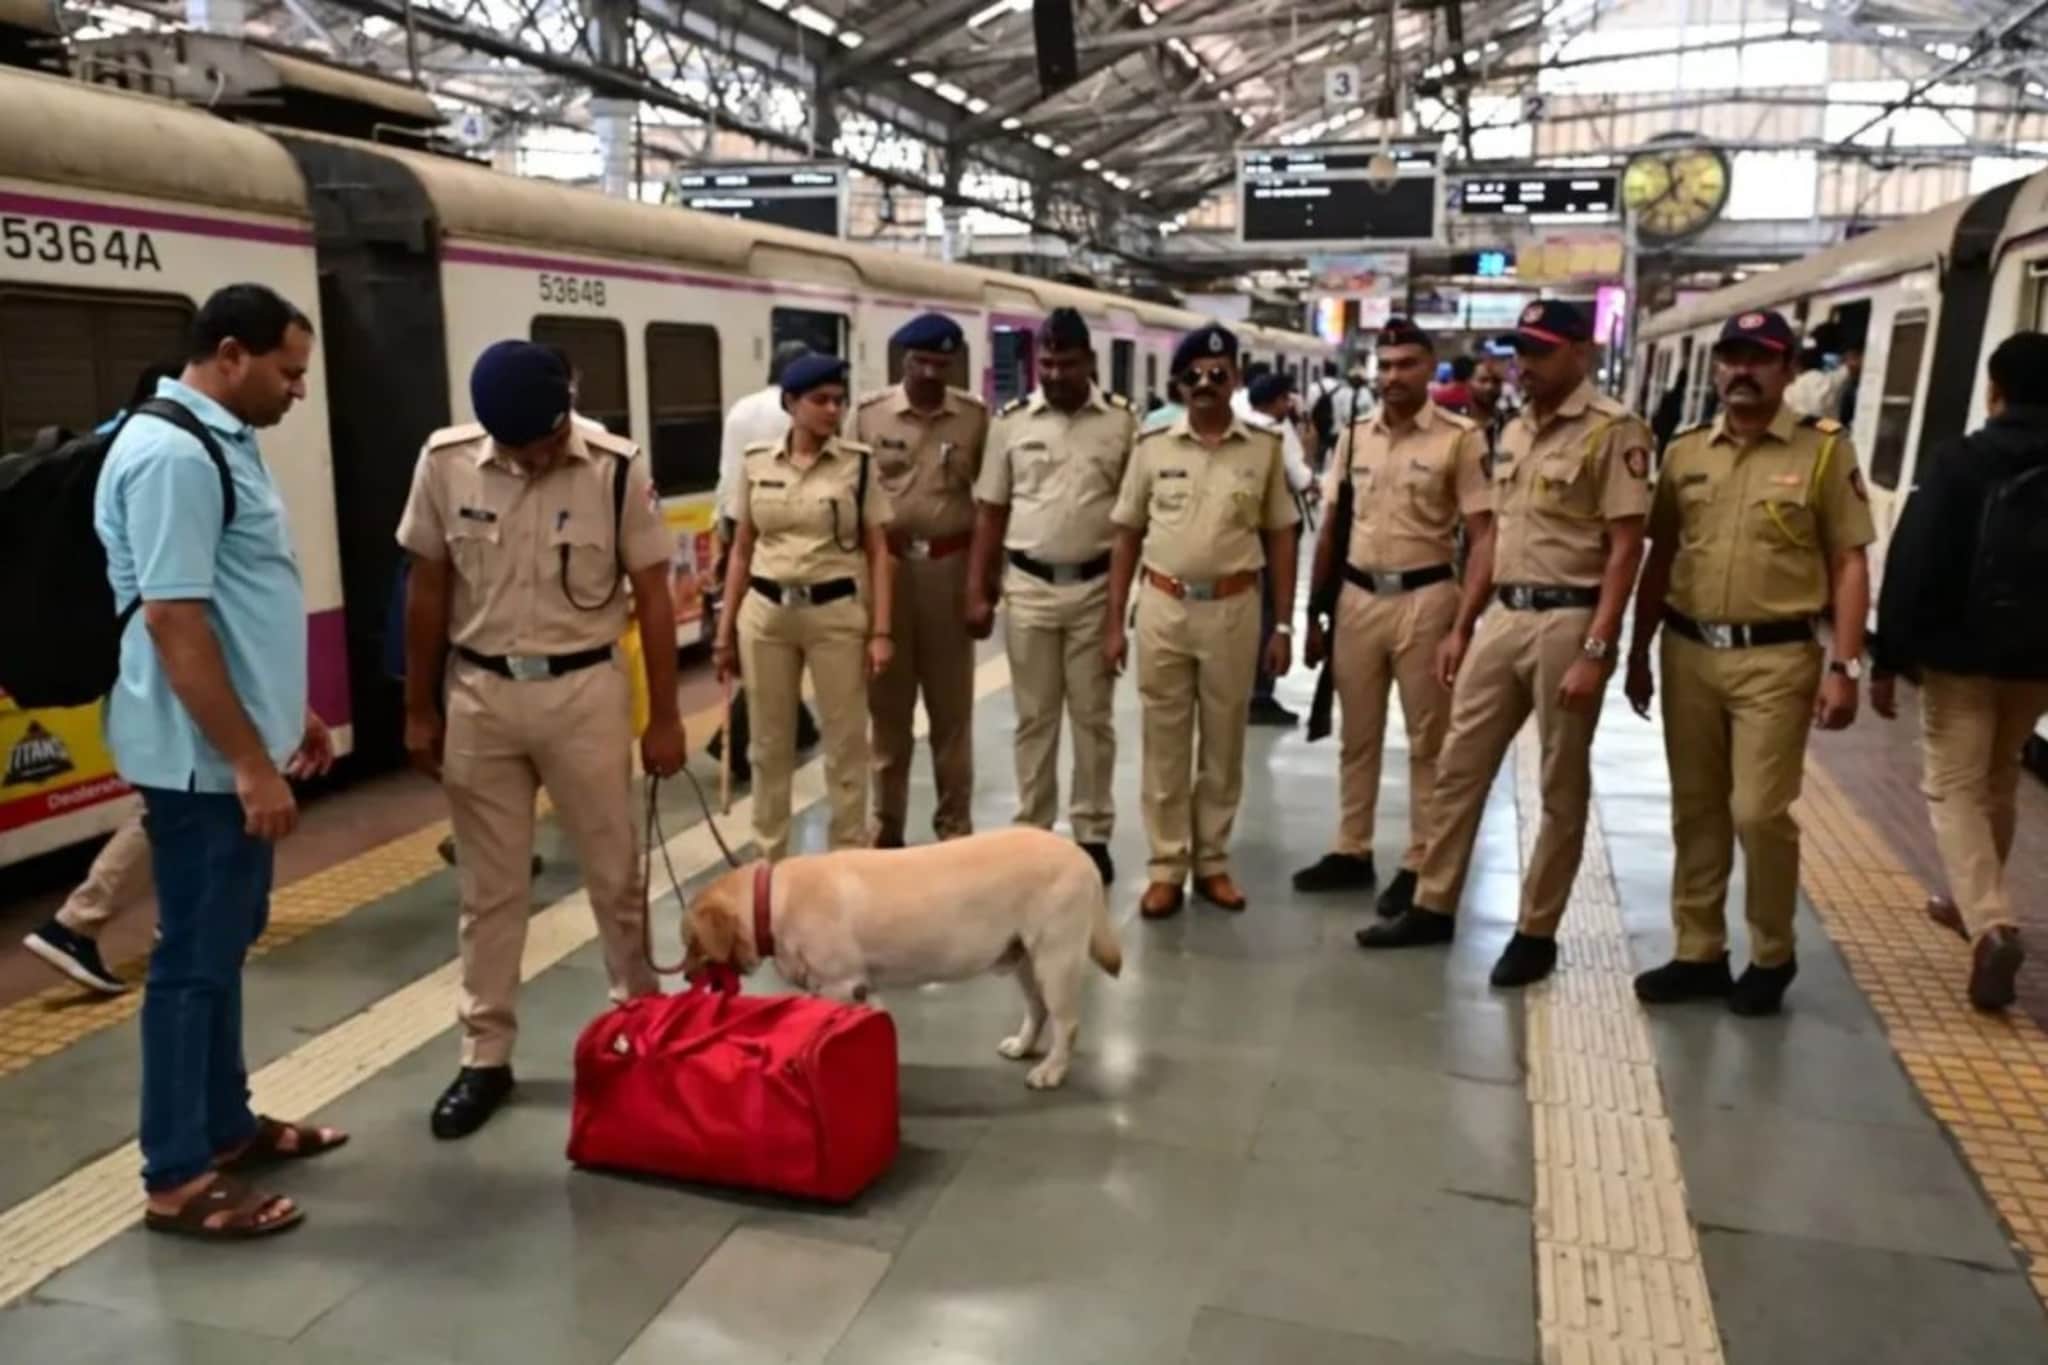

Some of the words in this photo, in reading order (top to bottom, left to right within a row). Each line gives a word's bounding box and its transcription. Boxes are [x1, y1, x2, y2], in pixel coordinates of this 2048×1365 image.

[1333, 72, 1352, 97] 3
[464, 117, 478, 136] 4
[2, 216, 162, 272] 5364A
